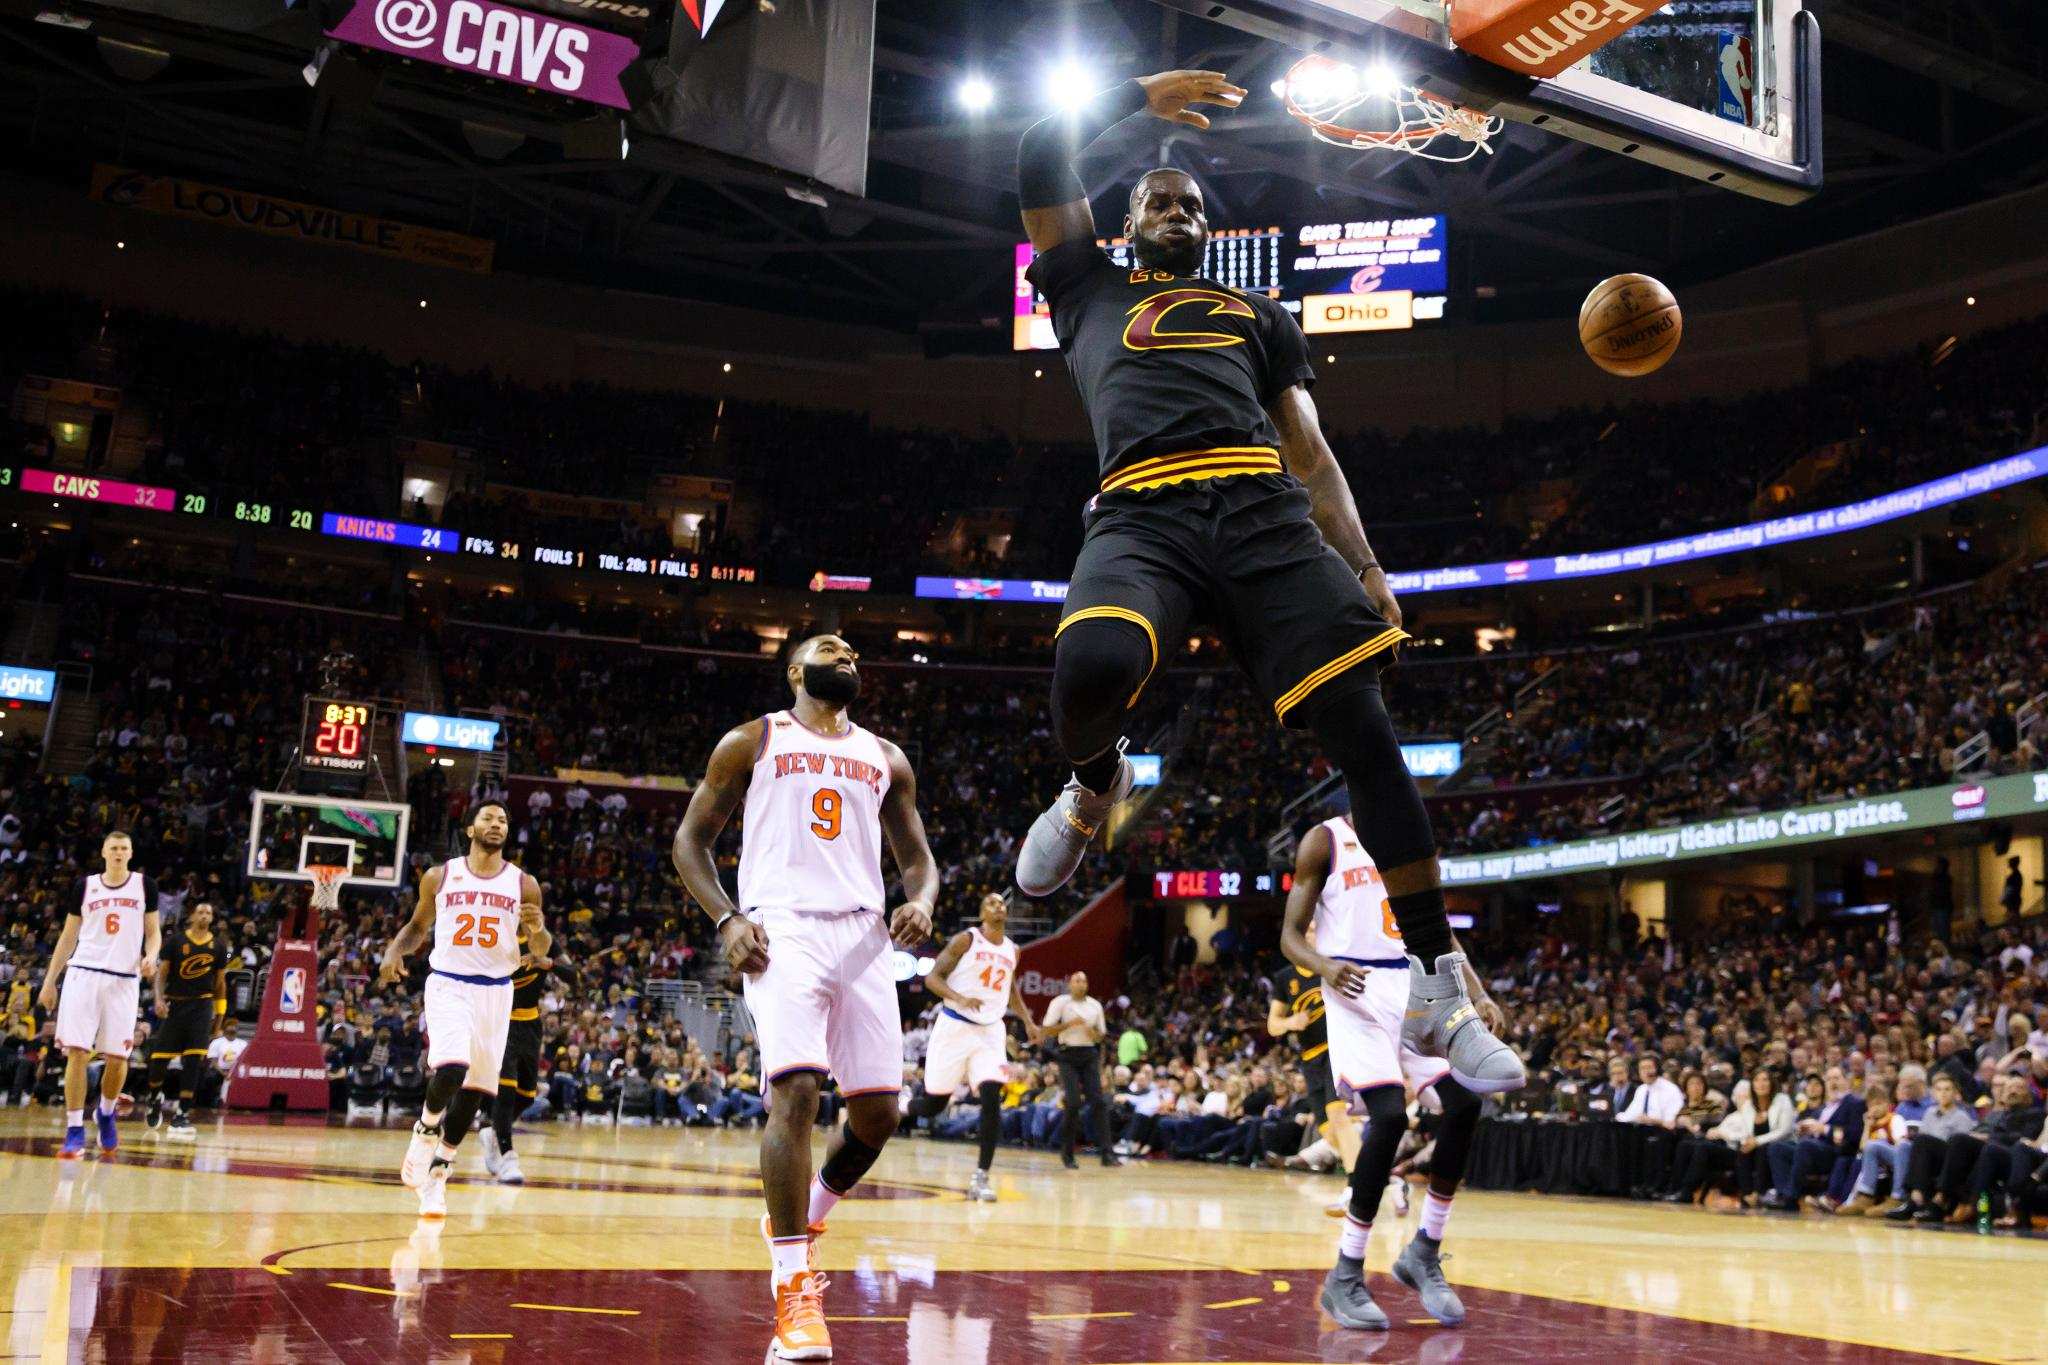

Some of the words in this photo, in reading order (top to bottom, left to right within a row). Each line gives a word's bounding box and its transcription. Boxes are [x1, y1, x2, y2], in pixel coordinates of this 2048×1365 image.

[374, 0, 590, 91] @CAVS
[1502, 0, 1645, 66] Farm
[1723, 101, 1744, 119] NBA
[173, 181, 402, 250] LOUDVILLE
[1325, 305, 1388, 321] Ohio
[1607, 312, 1674, 352] SPALDING
[53, 474, 100, 499] CAVS
[134, 487, 156, 507] 32
[235, 502, 271, 524] 8:38
[335, 515, 396, 541] KNICKS
[420, 529, 441, 549] 24
[1554, 552, 1622, 574] Redeem
[1622, 548, 1652, 567] any
[1654, 528, 1763, 560] non-winning
[1764, 515, 1814, 539] ticket
[1817, 511, 1835, 530] at
[501, 543, 519, 560] 34
[534, 546, 573, 566] FOULS
[577, 552, 584, 568] 1
[650, 558, 657, 575] 1
[659, 560, 688, 578] FULL
[689, 562, 698, 579] 5
[736, 567, 755, 583] PM
[0, 671, 44, 697] ight
[325, 704, 367, 726] 8:37
[316, 722, 360, 755] 20
[444, 722, 493, 748] Light
[323, 757, 366, 770] TISSOT
[775, 752, 826, 779] NEW
[829, 755, 884, 796] YORK
[1410, 749, 1454, 775] Light
[811, 787, 843, 841] 9
[1438, 858, 1481, 881] Turn
[1482, 856, 1513, 880] any
[1514, 840, 1619, 873] non-winning
[1618, 832, 1680, 859] lottery
[1681, 816, 1736, 850] ticket
[1736, 814, 1780, 844] into
[1780, 810, 1832, 837] Cavs
[1833, 800, 1909, 836] prizes.
[1177, 871, 1208, 896] CLE
[1219, 872, 1241, 896] 32
[88, 897, 110, 913] NEW
[113, 897, 139, 910] YORK
[446, 890, 479, 908] NEW
[480, 891, 517, 914] YORK
[105, 913, 121, 935] 6
[452, 913, 500, 949] 25
[979, 965, 1006, 992] 42
[249, 1066, 267, 1078] NBA
[268, 1066, 302, 1079] LEAGUE
[302, 1068, 326, 1080] PASS
